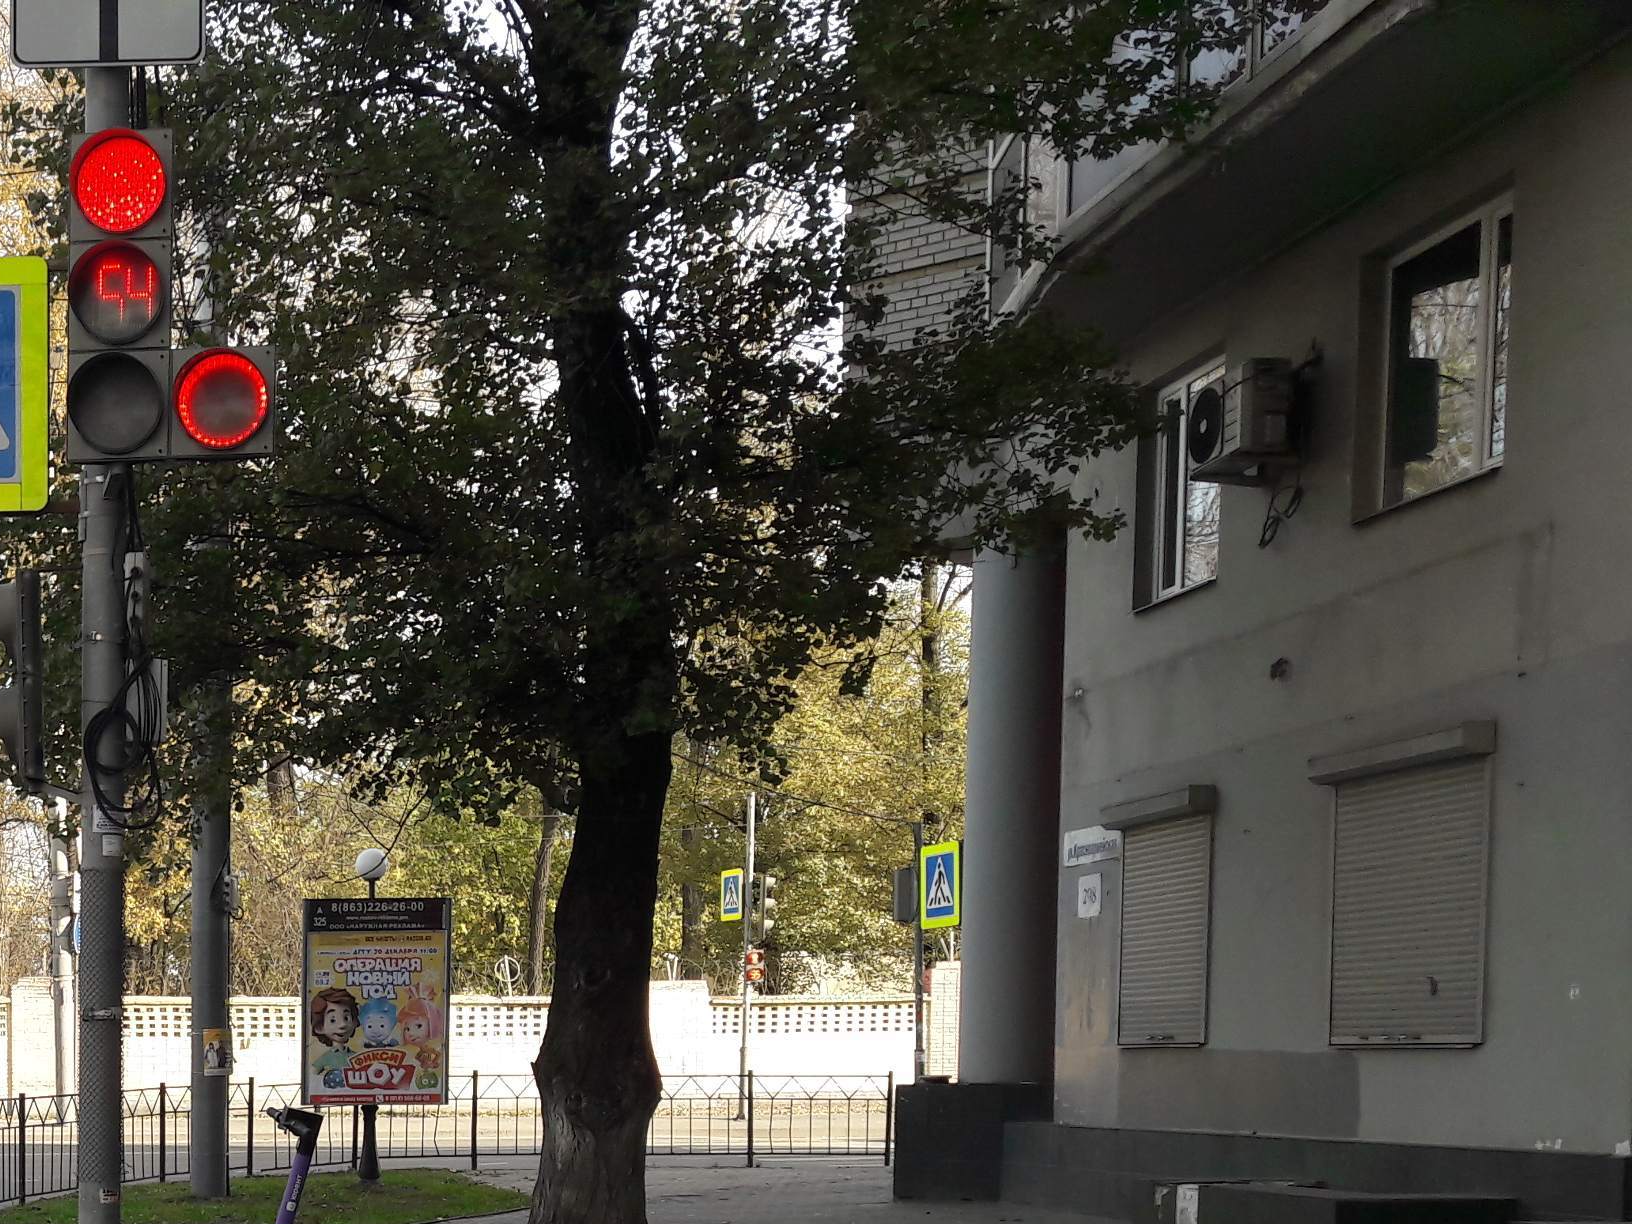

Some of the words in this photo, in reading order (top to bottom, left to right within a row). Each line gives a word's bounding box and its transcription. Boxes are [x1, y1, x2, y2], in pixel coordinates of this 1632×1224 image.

[331, 901, 424, 914] 8(863)226-26-00
[313, 917, 326, 927] 325
[333, 957, 423, 973] ОПЕРАЦИЯ
[346, 968, 411, 986] НОВЫЙ
[361, 984, 397, 999] ГОД
[354, 1051, 400, 1066] ФИКСИ
[348, 1062, 407, 1086] ШОУ
